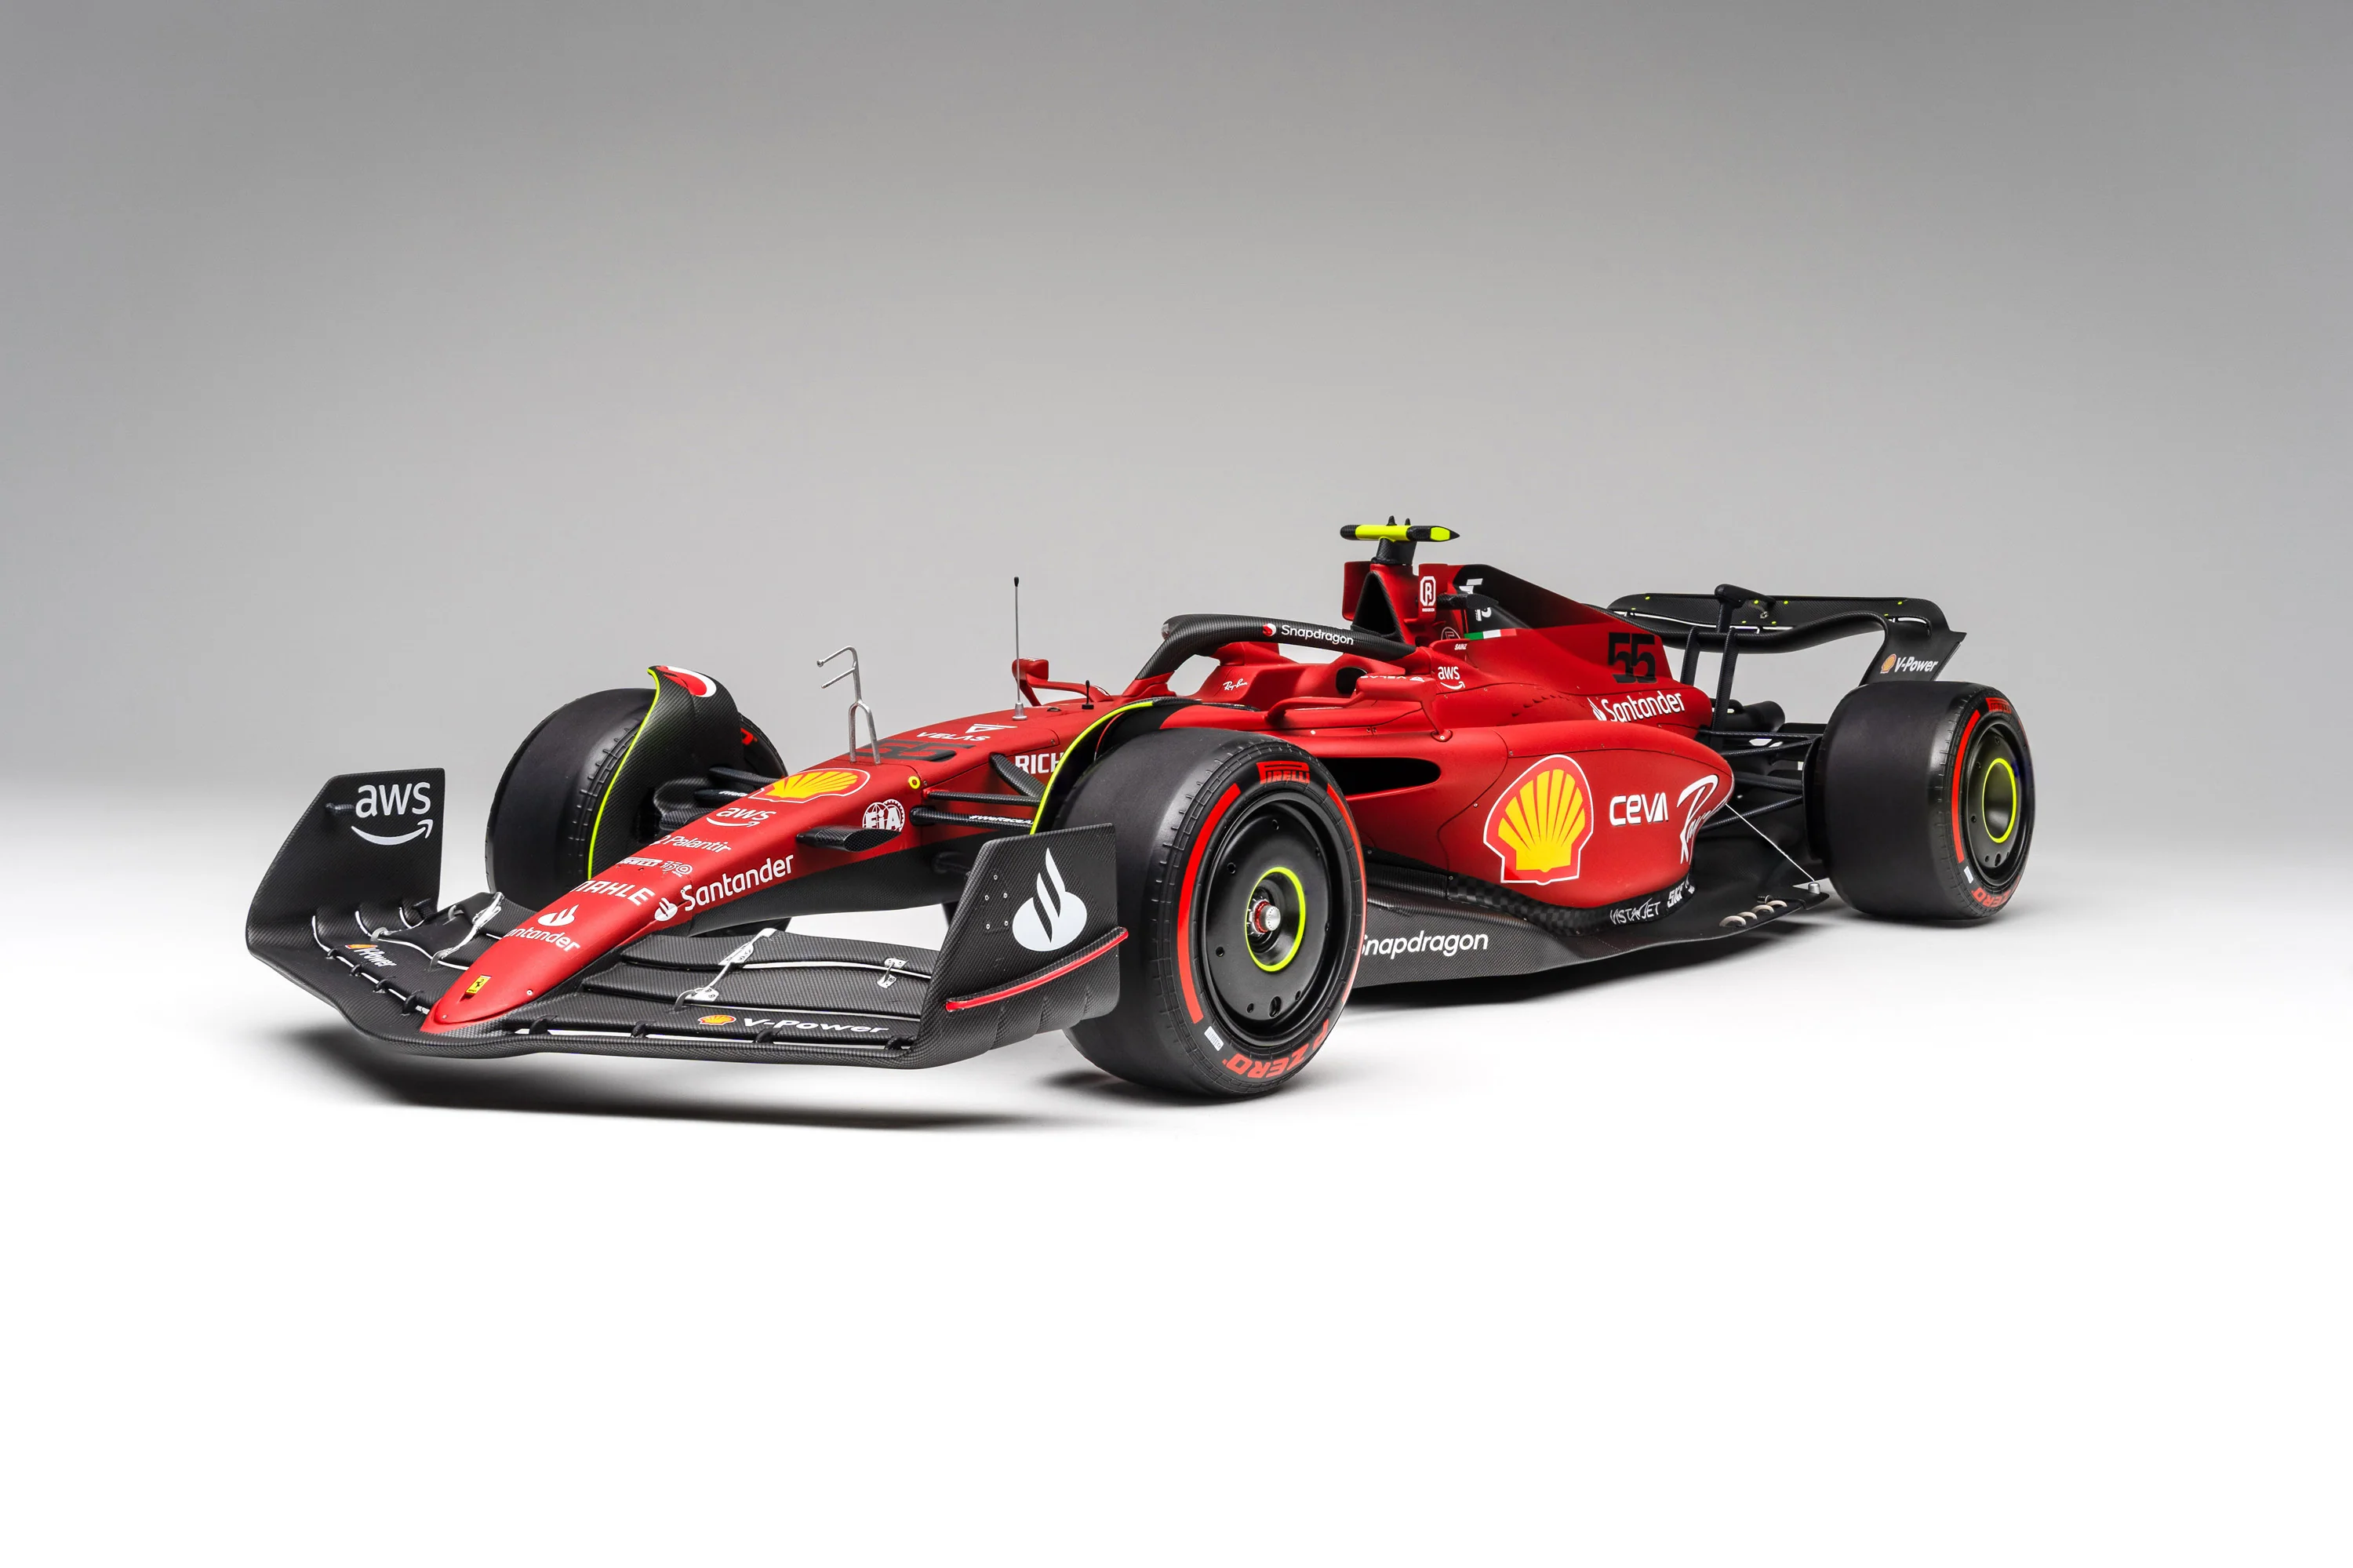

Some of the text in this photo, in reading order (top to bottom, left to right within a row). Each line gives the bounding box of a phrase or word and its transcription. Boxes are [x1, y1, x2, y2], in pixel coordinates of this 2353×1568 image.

[1281, 624, 1354, 646] Snapdragon
[1608, 632, 1657, 684] 55
[1894, 657, 1939, 672] V-Power
[1438, 666, 1460, 680] aws
[1223, 678, 1249, 691] Ray-Ban
[1601, 690, 1686, 722] Santander
[916, 732, 991, 741] VELAS
[1256, 760, 1311, 784] PIRELLI
[355, 781, 431, 818] aws
[715, 807, 776, 820] aws
[663, 835, 732, 853] Palantir
[680, 855, 794, 911] Santander
[503, 927, 580, 951] antander
[744, 1018, 889, 1033] V-Power
[1224, 1043, 1309, 1079] ZERO
